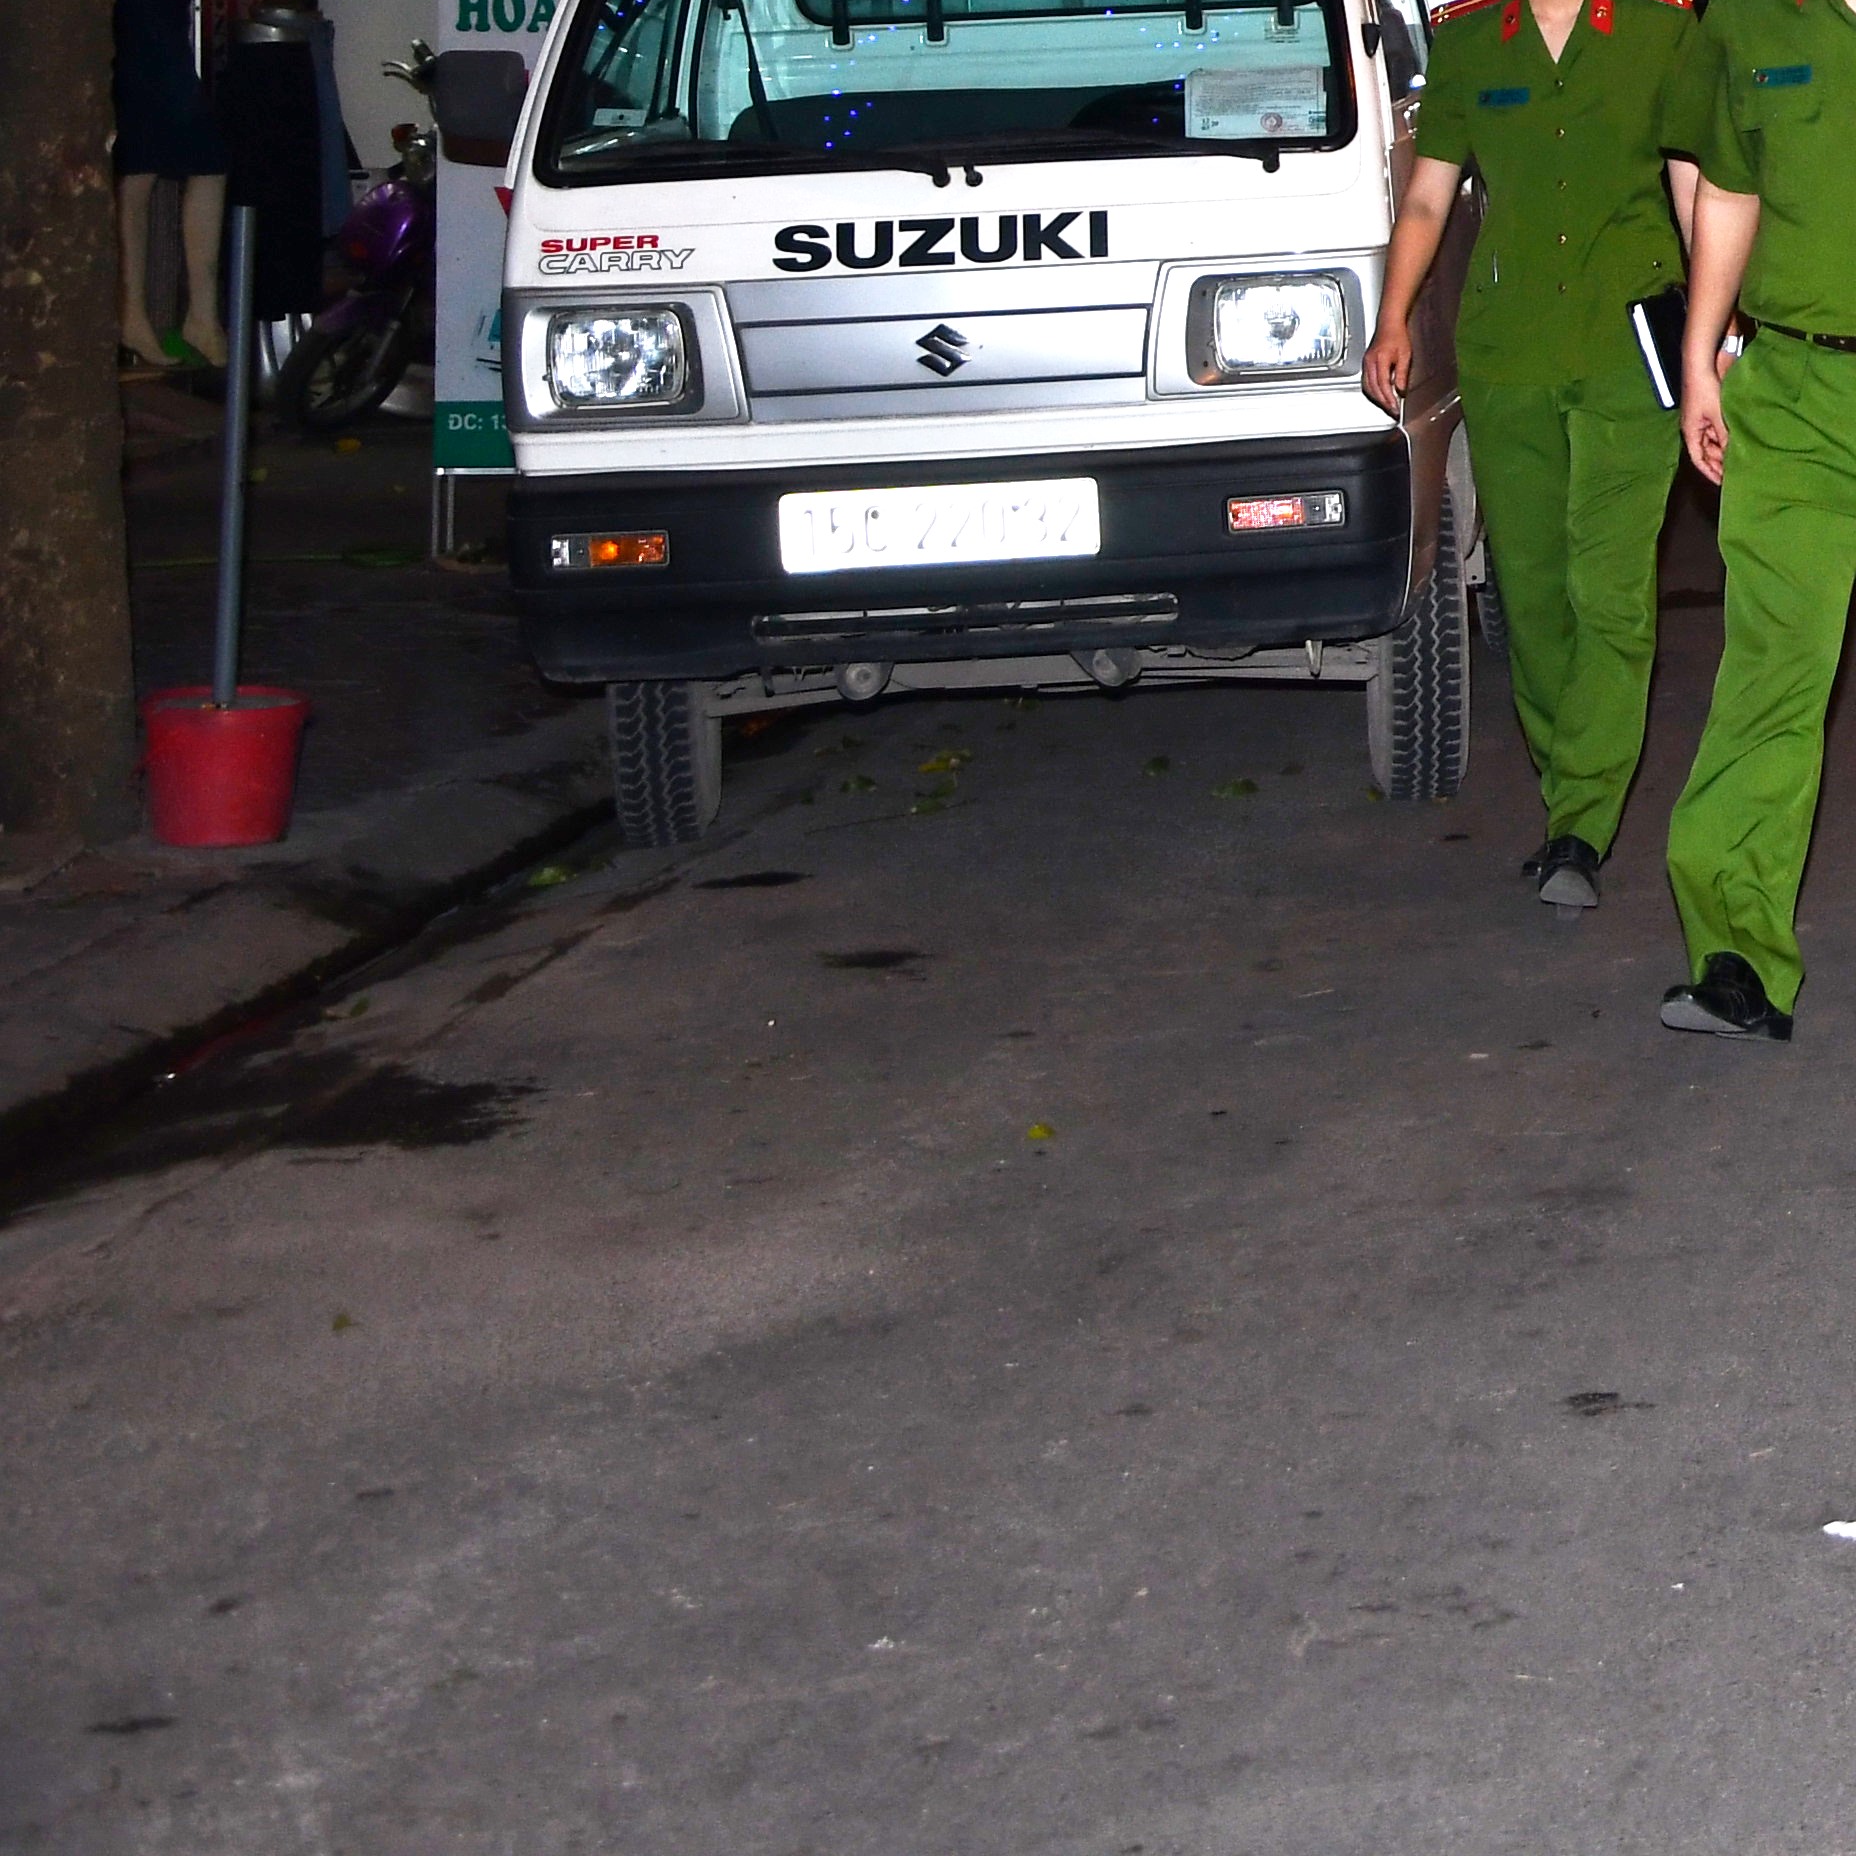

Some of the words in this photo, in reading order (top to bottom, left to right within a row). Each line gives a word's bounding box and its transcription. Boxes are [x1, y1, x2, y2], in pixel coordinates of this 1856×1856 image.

[540, 234, 660, 254] SUPER
[772, 210, 1109, 273] SUZUKI
[538, 247, 696, 275] CARRY
[448, 414, 486, 431] ĐC:
